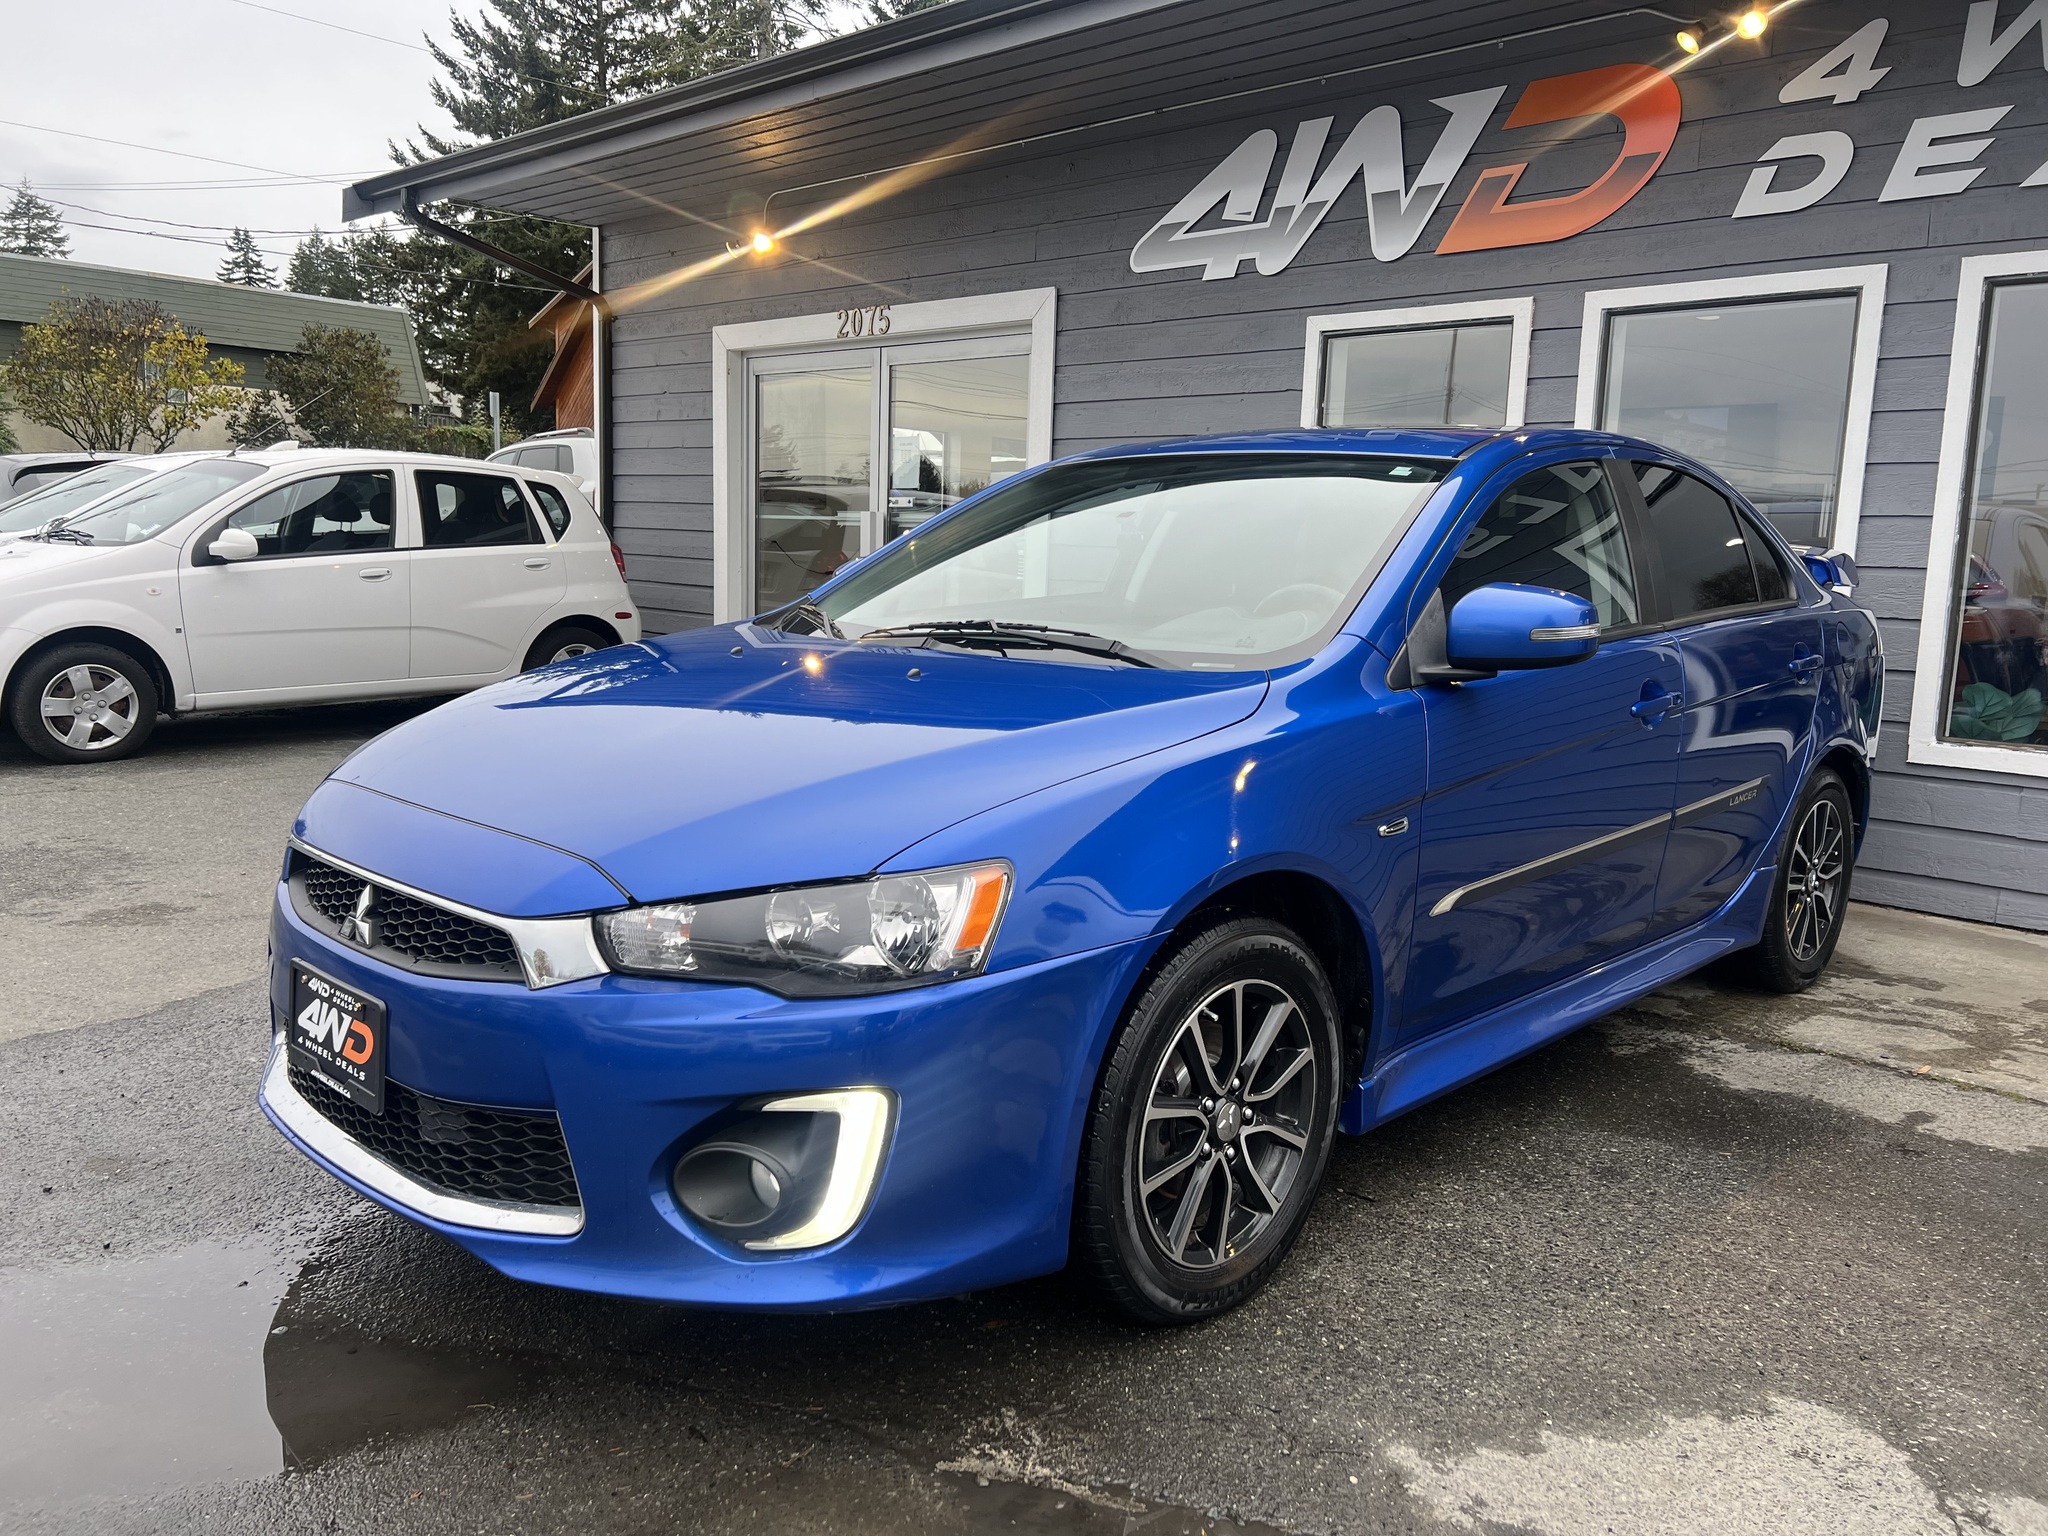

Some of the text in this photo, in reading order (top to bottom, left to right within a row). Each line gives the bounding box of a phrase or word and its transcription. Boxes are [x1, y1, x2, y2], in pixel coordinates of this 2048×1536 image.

[1778, 18, 1891, 104] 4
[1129, 62, 1682, 281] 4WD
[1731, 104, 2048, 219] DE
[837, 304, 891, 339] 2075
[1729, 789, 1758, 806] LANCER
[332, 997, 353, 1011] DEALS
[335, 989, 356, 1003] WHEEL
[297, 998, 375, 1065] 4WD
[297, 1035, 366, 1081] 4 WHEEL DEALS
